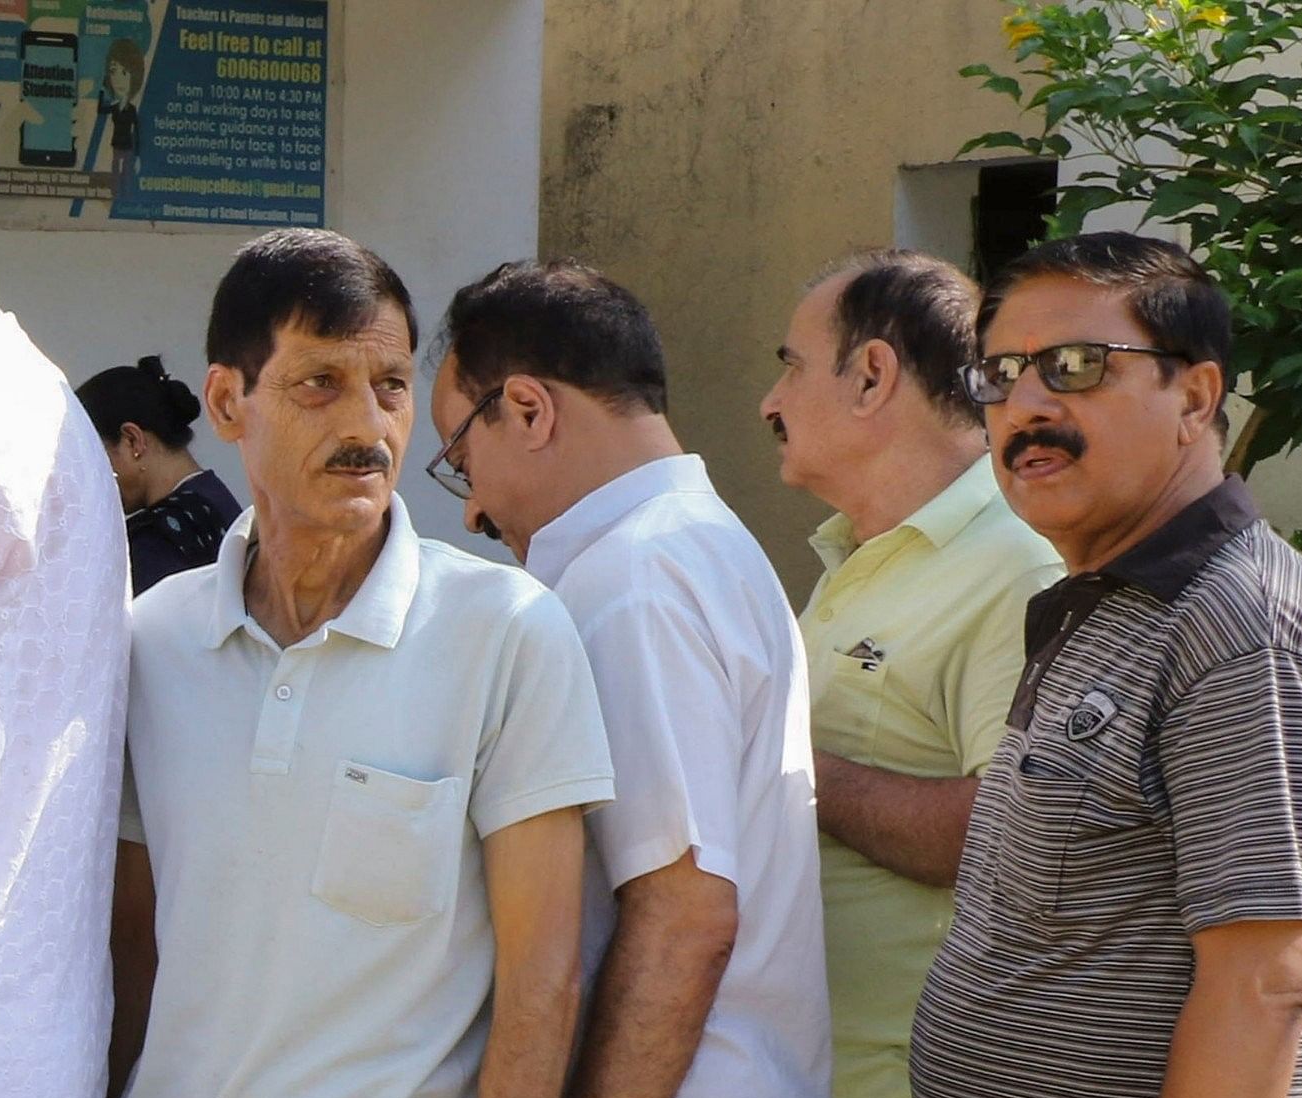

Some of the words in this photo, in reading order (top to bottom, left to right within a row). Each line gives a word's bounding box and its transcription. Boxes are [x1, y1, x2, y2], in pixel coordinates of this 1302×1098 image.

[179, 28, 214, 52] Feel
[217, 30, 250, 54] free
[253, 35, 269, 55] to
[273, 36, 303, 57] call
[305, 39, 322, 58] at
[216, 57, 322, 83] 6006800068
[176, 82, 203, 97] from
[210, 84, 240, 100] 10:00
[243, 87, 262, 102] AM
[264, 89, 276, 102] to
[305, 90, 322, 104] PM
[167, 102, 182, 113] on
[185, 100, 199, 114] all
[202, 102, 247, 120] working
[250, 104, 278, 122] days
[280, 106, 293, 120] to
[294, 107, 321, 121] seek
[153, 115, 216, 133] telephonic
[219, 120, 274, 136] guidance
[277, 126, 289, 136] or
[292, 123, 321, 138] book
[153, 134, 228, 150] appointment
[230, 137, 246, 151] for
[249, 137, 276, 153] face
[281, 140, 293, 153] to
[294, 140, 322, 155] face
[166, 152, 233, 170] counselling
[235, 157, 248, 168] or
[250, 155, 278, 170] write
[279, 156, 292, 170] to
[294, 159, 307, 171] us
[309, 158, 321, 172] at
